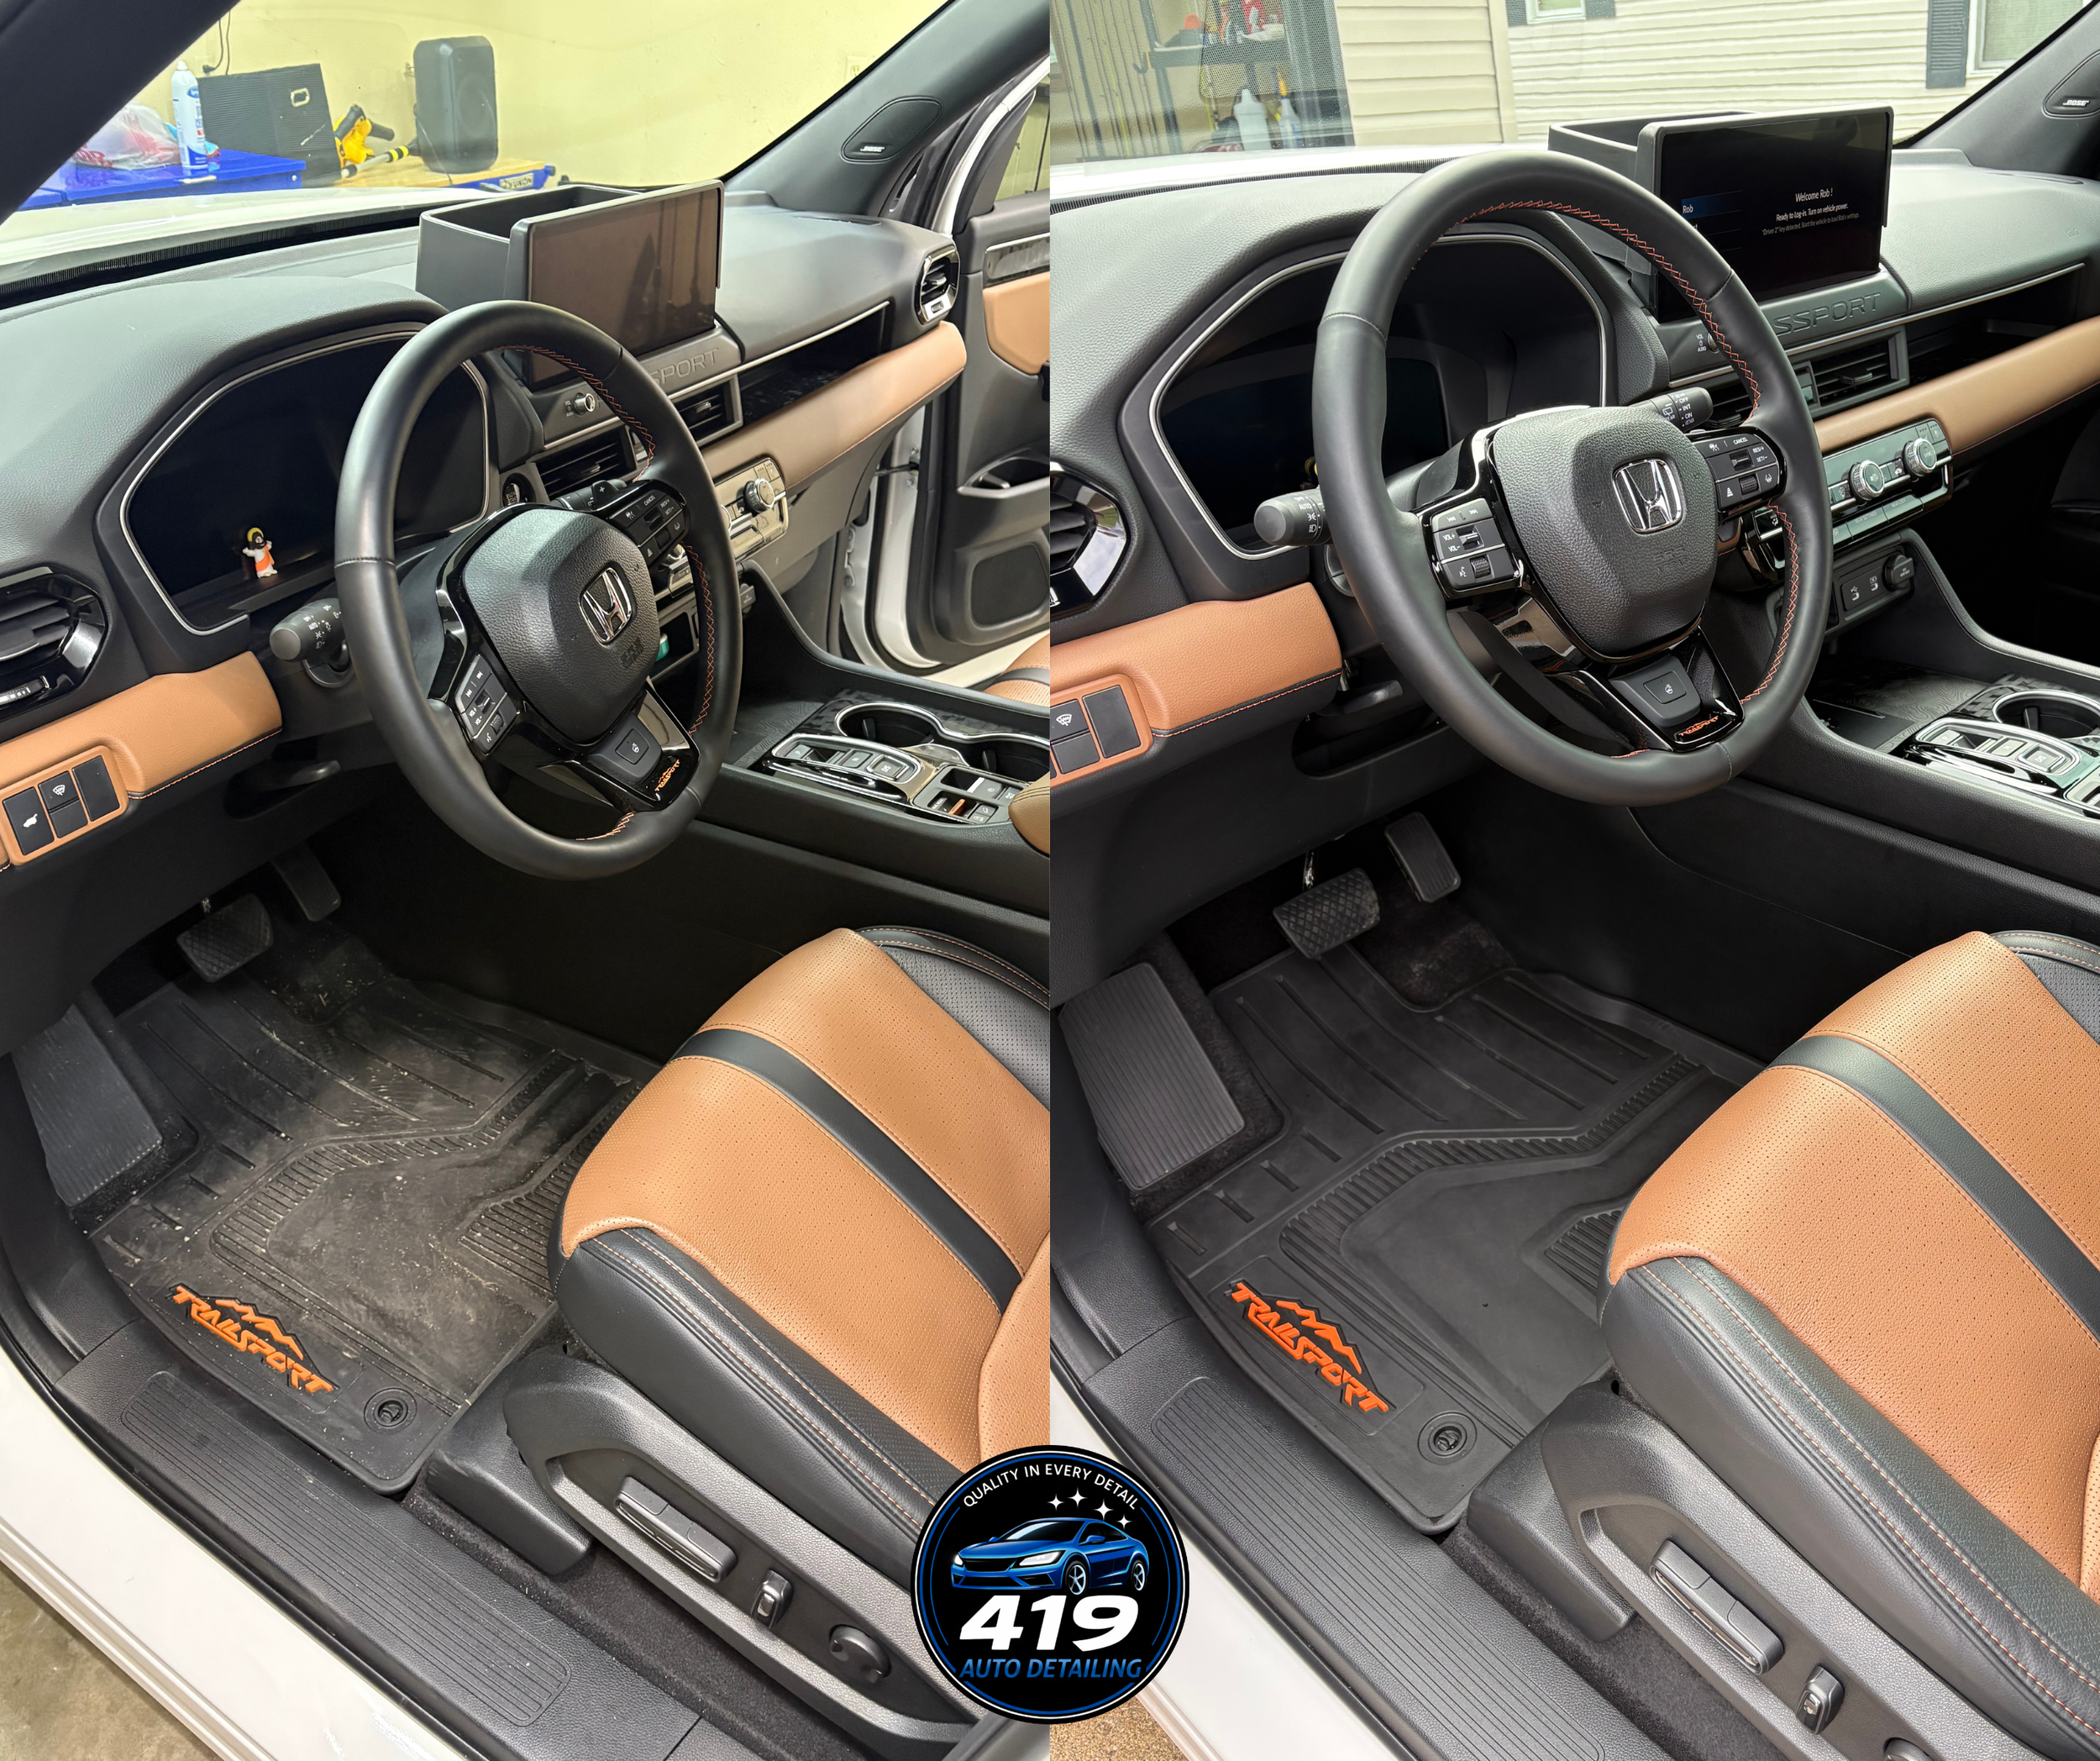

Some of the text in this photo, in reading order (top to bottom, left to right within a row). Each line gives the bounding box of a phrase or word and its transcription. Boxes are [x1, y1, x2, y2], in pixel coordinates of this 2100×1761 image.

[1795, 192, 1819, 202] Welcome
[1819, 188, 1830, 198] Rob
[1683, 205, 1693, 213] Rob
[1776, 212, 1788, 222] Ready
[1823, 204, 1835, 213] vehicle
[1835, 202, 1848, 212] power.
[1815, 218, 1827, 226] vehicle
[1682, 403, 1691, 412] INT
[1684, 411, 1693, 419] ON
[1733, 437, 1748, 445] CANCEL
[1751, 445, 1765, 454] RES/+
[643, 494, 656, 507] CANCEL
[1442, 533, 1456, 541] VOL+
[172, 1285, 333, 1393] TRAILSPORT
[1231, 1282, 1389, 1411] TRAILSPORT
